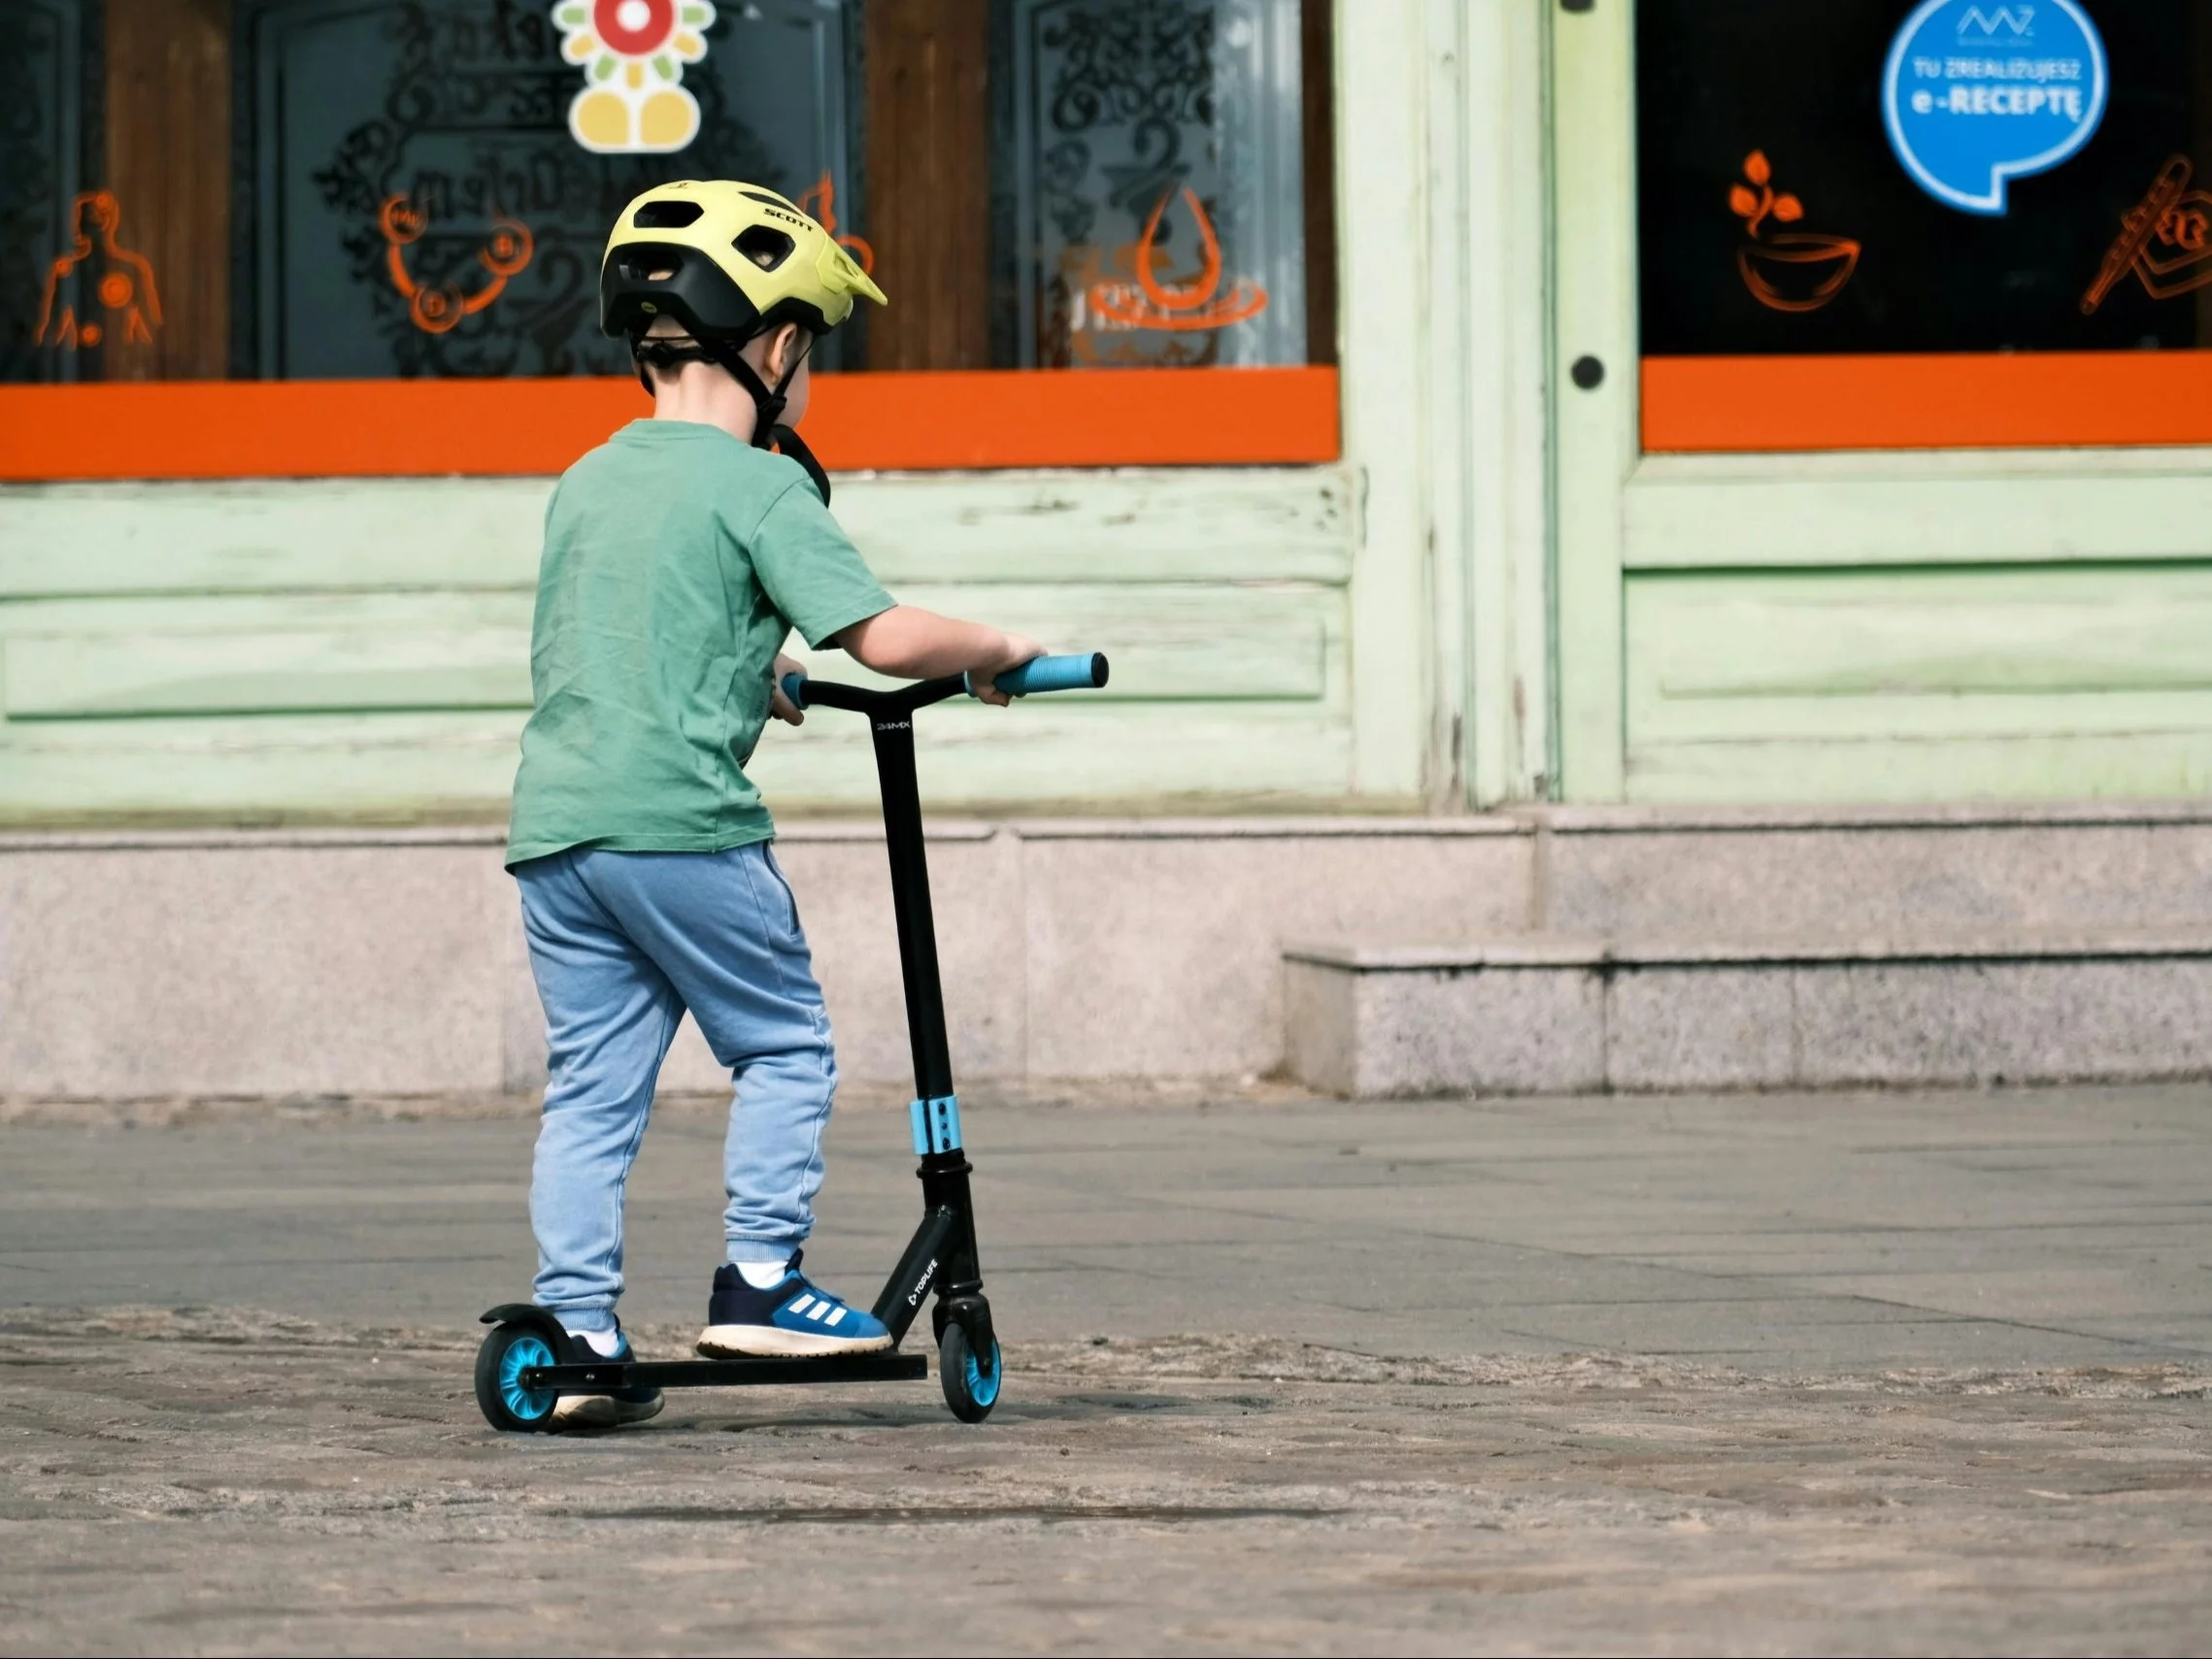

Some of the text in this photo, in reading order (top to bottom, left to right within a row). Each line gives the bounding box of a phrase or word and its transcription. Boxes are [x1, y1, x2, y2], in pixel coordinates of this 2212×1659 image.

[1913, 56, 1941, 79] TU
[1911, 85, 2082, 122] e-RECEPTĘ
[763, 208, 813, 232] SCOTT
[914, 1258, 938, 1295] TOPLIFE
